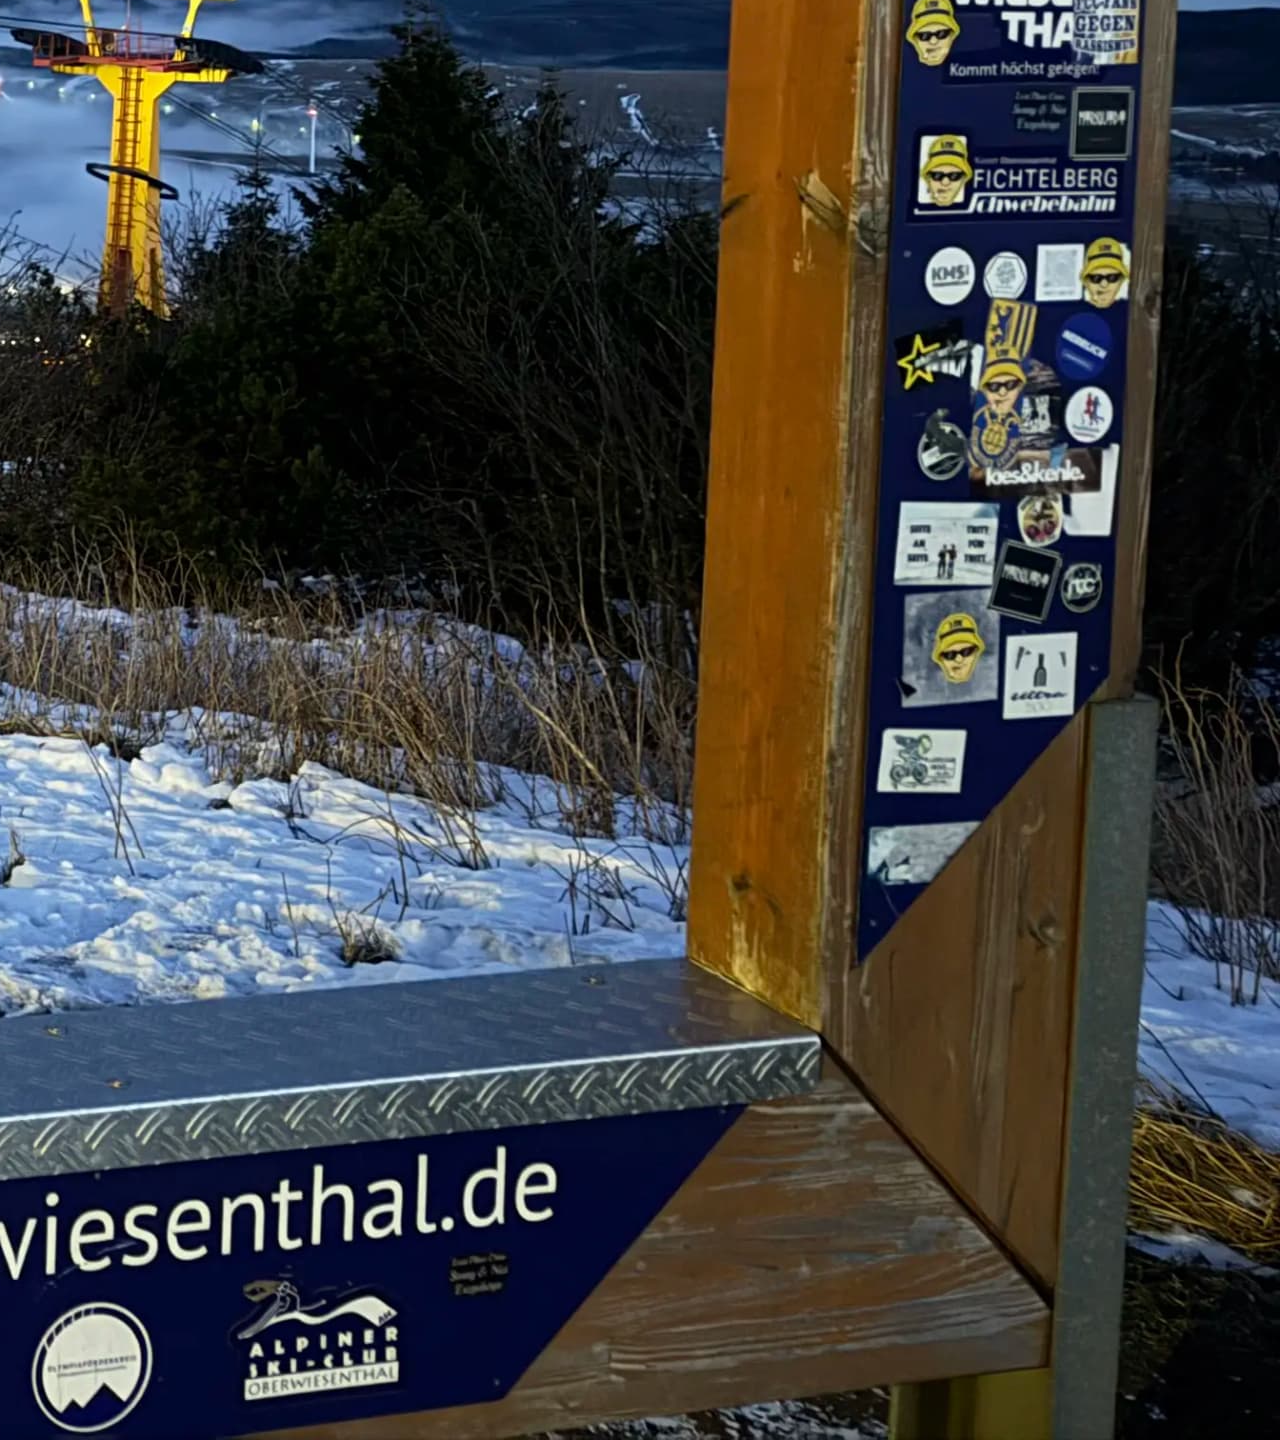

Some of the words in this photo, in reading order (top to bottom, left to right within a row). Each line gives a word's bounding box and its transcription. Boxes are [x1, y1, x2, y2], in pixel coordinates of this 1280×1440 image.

[1001, 11, 1075, 48] THA
[1075, 14, 1137, 32] GEGEN
[950, 63, 997, 77] Kommt
[1000, 61, 1045, 77] höchst
[973, 167, 1118, 189] FICHTELBERG
[968, 191, 1117, 213] Schwebebahn
[248, 1326, 398, 1359] ALPINER
[249, 1346, 398, 1378] SKI-CLUB
[248, 1365, 396, 1396] OBERWIESENTHAL
